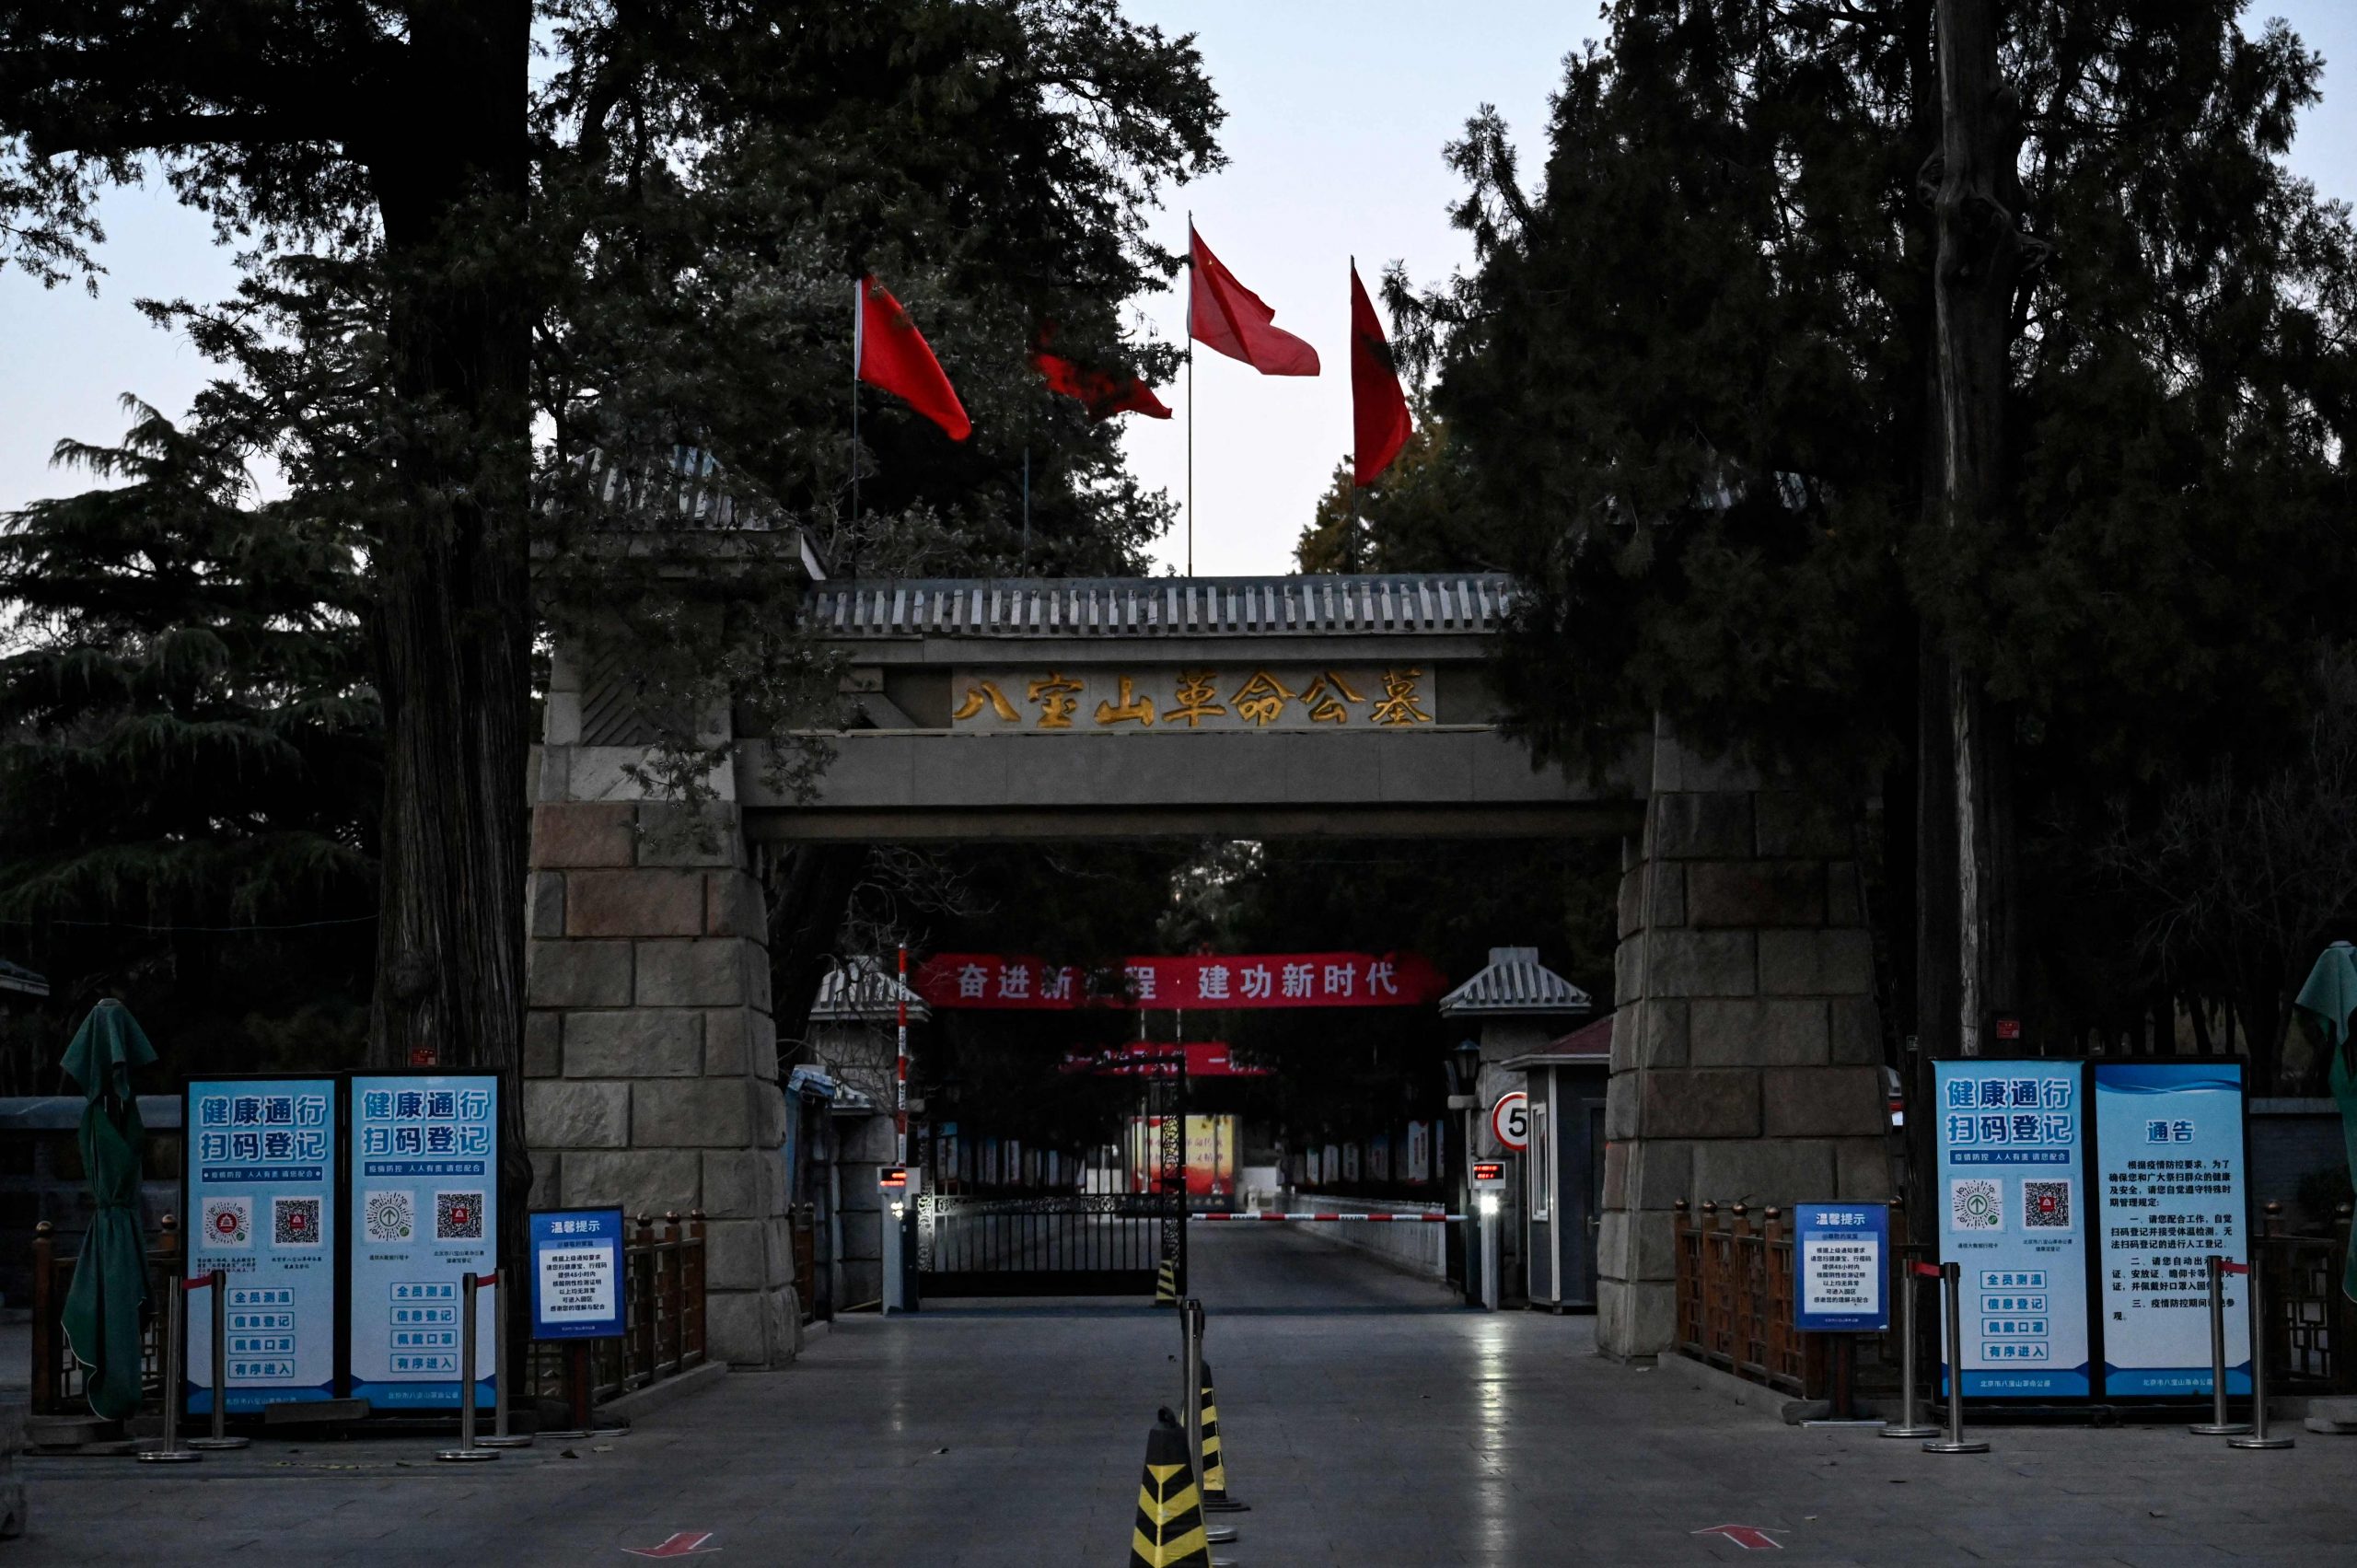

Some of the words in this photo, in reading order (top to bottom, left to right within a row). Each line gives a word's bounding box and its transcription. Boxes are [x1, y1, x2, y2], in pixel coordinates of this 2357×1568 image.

[953, 668, 1434, 729] 八宝山革命公墓
[958, 963, 1156, 1000] 奋进新程
[1198, 961, 1398, 999] 建功新时代
[1946, 1078, 2071, 1108] 健康通行
[201, 1096, 325, 1125] 健康通行
[364, 1091, 488, 1121] 健康通行
[1508, 1108, 1527, 1137] 5
[1947, 1114, 2073, 1144] 扫码登记
[2146, 1120, 2194, 1144] 通告
[201, 1132, 326, 1161] 扫码登记
[364, 1126, 488, 1155] 扫码登记
[1955, 1153, 1989, 1161] 疫情防控
[1995, 1153, 2028, 1161] 人人有责
[2032, 1153, 2066, 1161] 请您配合
[409, 1164, 443, 1172] 人人有责
[447, 1164, 481, 1172] 请您配合
[2128, 1159, 2229, 1169] 根据疫情防控要求，为了
[2108, 1172, 2231, 1182] 确保您和广大祭扫群众的健康
[2109, 1185, 2231, 1195] 及安全，请您自觉遵守特殊时
[1816, 1213, 1865, 1225] 温馨提示
[2130, 1214, 2233, 1224] 一、请您配合工作，自觉
[551, 1220, 600, 1234] 温馨提示
[2111, 1226, 2233, 1237] 扫码登记并接受体温检测。无
[2111, 1239, 2227, 1249] 法扫码登记的进行人工登记。
[2131, 1256, 2235, 1266] 二、请您自动出存
[1987, 1274, 2042, 1286] 全员测温
[398, 1286, 452, 1297] 全员测温
[2113, 1282, 2228, 1291] 证，并佩戴好口罩入园。
[235, 1291, 290, 1303] 全员测温
[2132, 1298, 2235, 1308] 三、疫情防控期间参
[1988, 1298, 2043, 1310] 信息登记
[398, 1310, 452, 1321] 信息登记
[235, 1316, 290, 1328] 信息登记
[1989, 1321, 2043, 1333] 佩戴口罩
[398, 1333, 452, 1344] 佩戴口罩
[235, 1339, 290, 1351] 佩戴口罩
[1989, 1345, 2044, 1357] 有序进入
[398, 1357, 452, 1369] 有序进入
[236, 1364, 290, 1375] 有序进入
